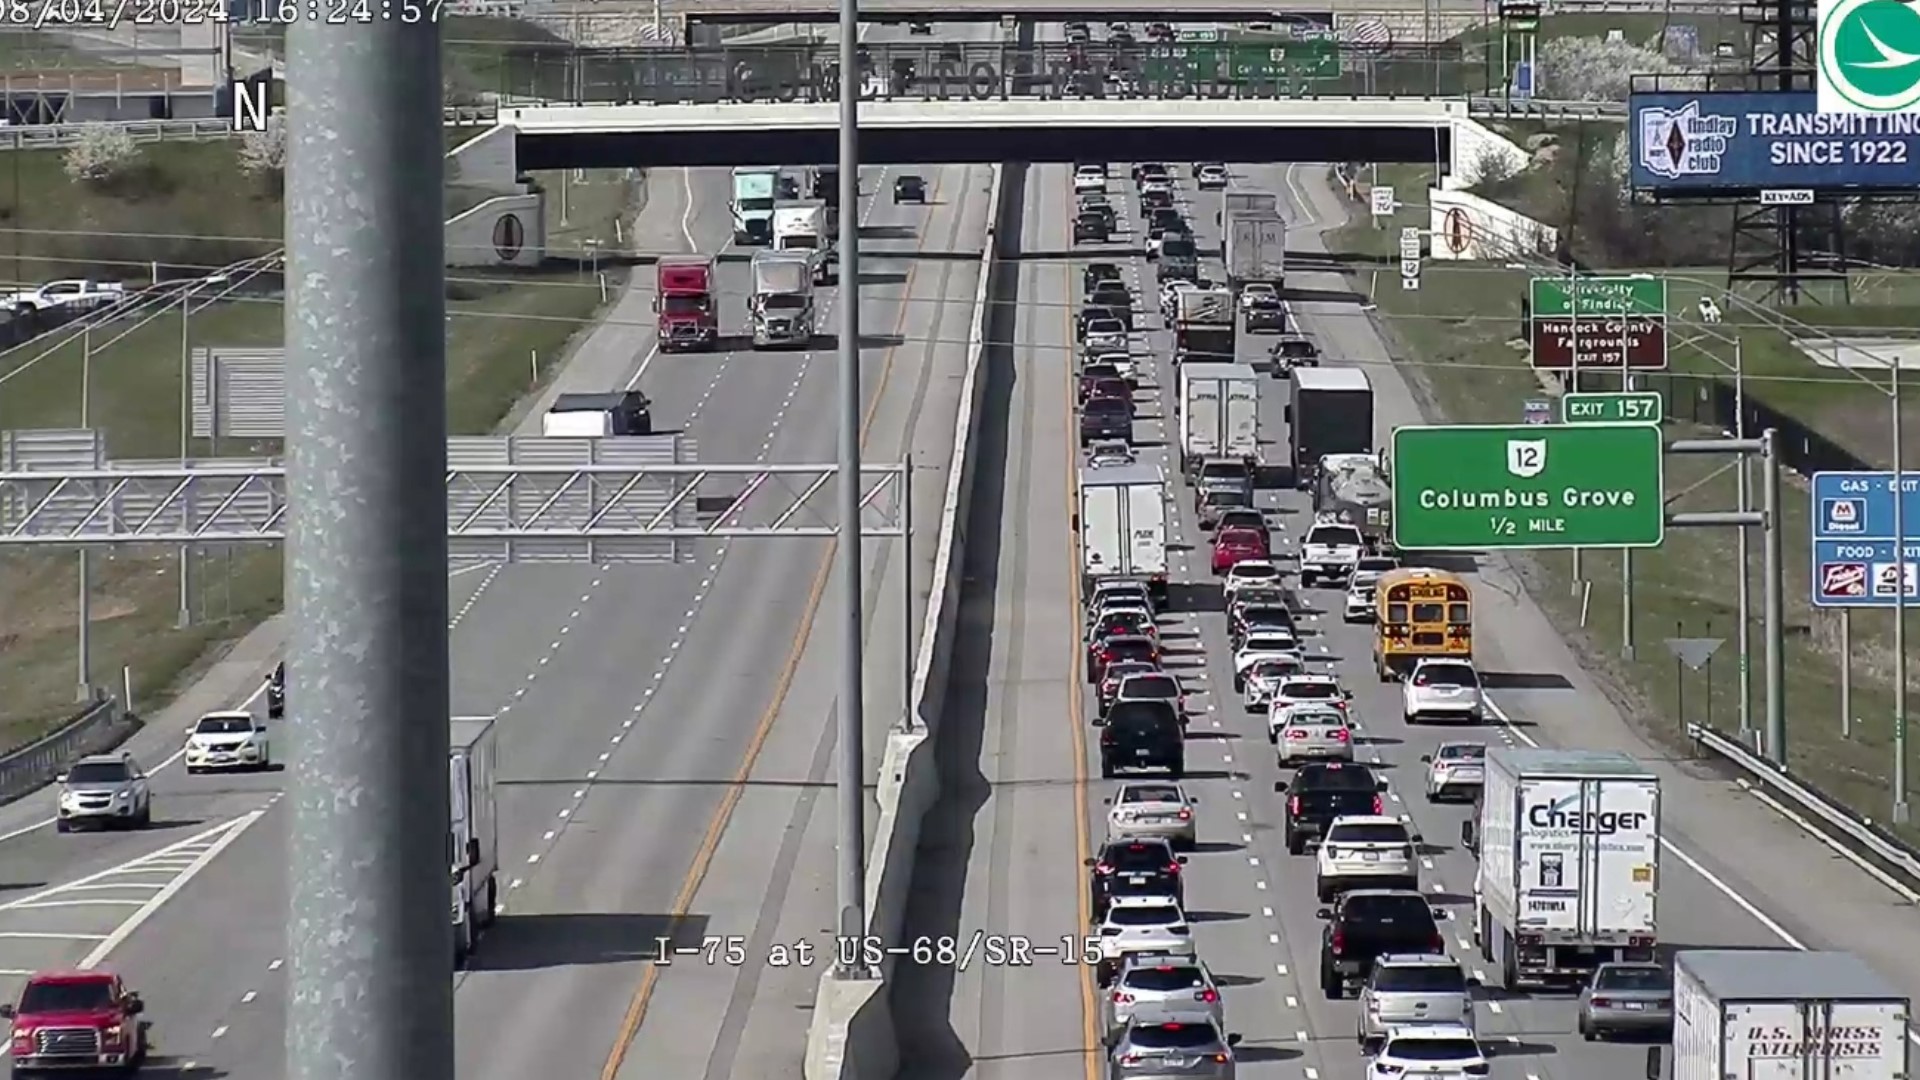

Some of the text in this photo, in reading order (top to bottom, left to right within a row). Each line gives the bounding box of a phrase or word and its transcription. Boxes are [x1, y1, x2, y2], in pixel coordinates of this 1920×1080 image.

[1688, 118, 1735, 135] findlay
[1688, 137, 1724, 153] radio
[1770, 141, 1907, 164] SINCE 1922
[1688, 155, 1719, 171] club
[1605, 322, 1653, 334] Conty
[1557, 338, 1640, 349] Fargrouns
[1602, 353, 1621, 362] 157
[1571, 400, 1654, 418] EXIT 157
[1516, 448, 1538, 467] 12
[1840, 481, 1869, 492] GAS
[1420, 488, 1636, 508] Columbus Grove
[1529, 519, 1565, 531] MILE
[1836, 546, 1874, 558] FOOD
[1529, 799, 1647, 835] Charger
[1748, 1027, 1792, 1040] U.S.
